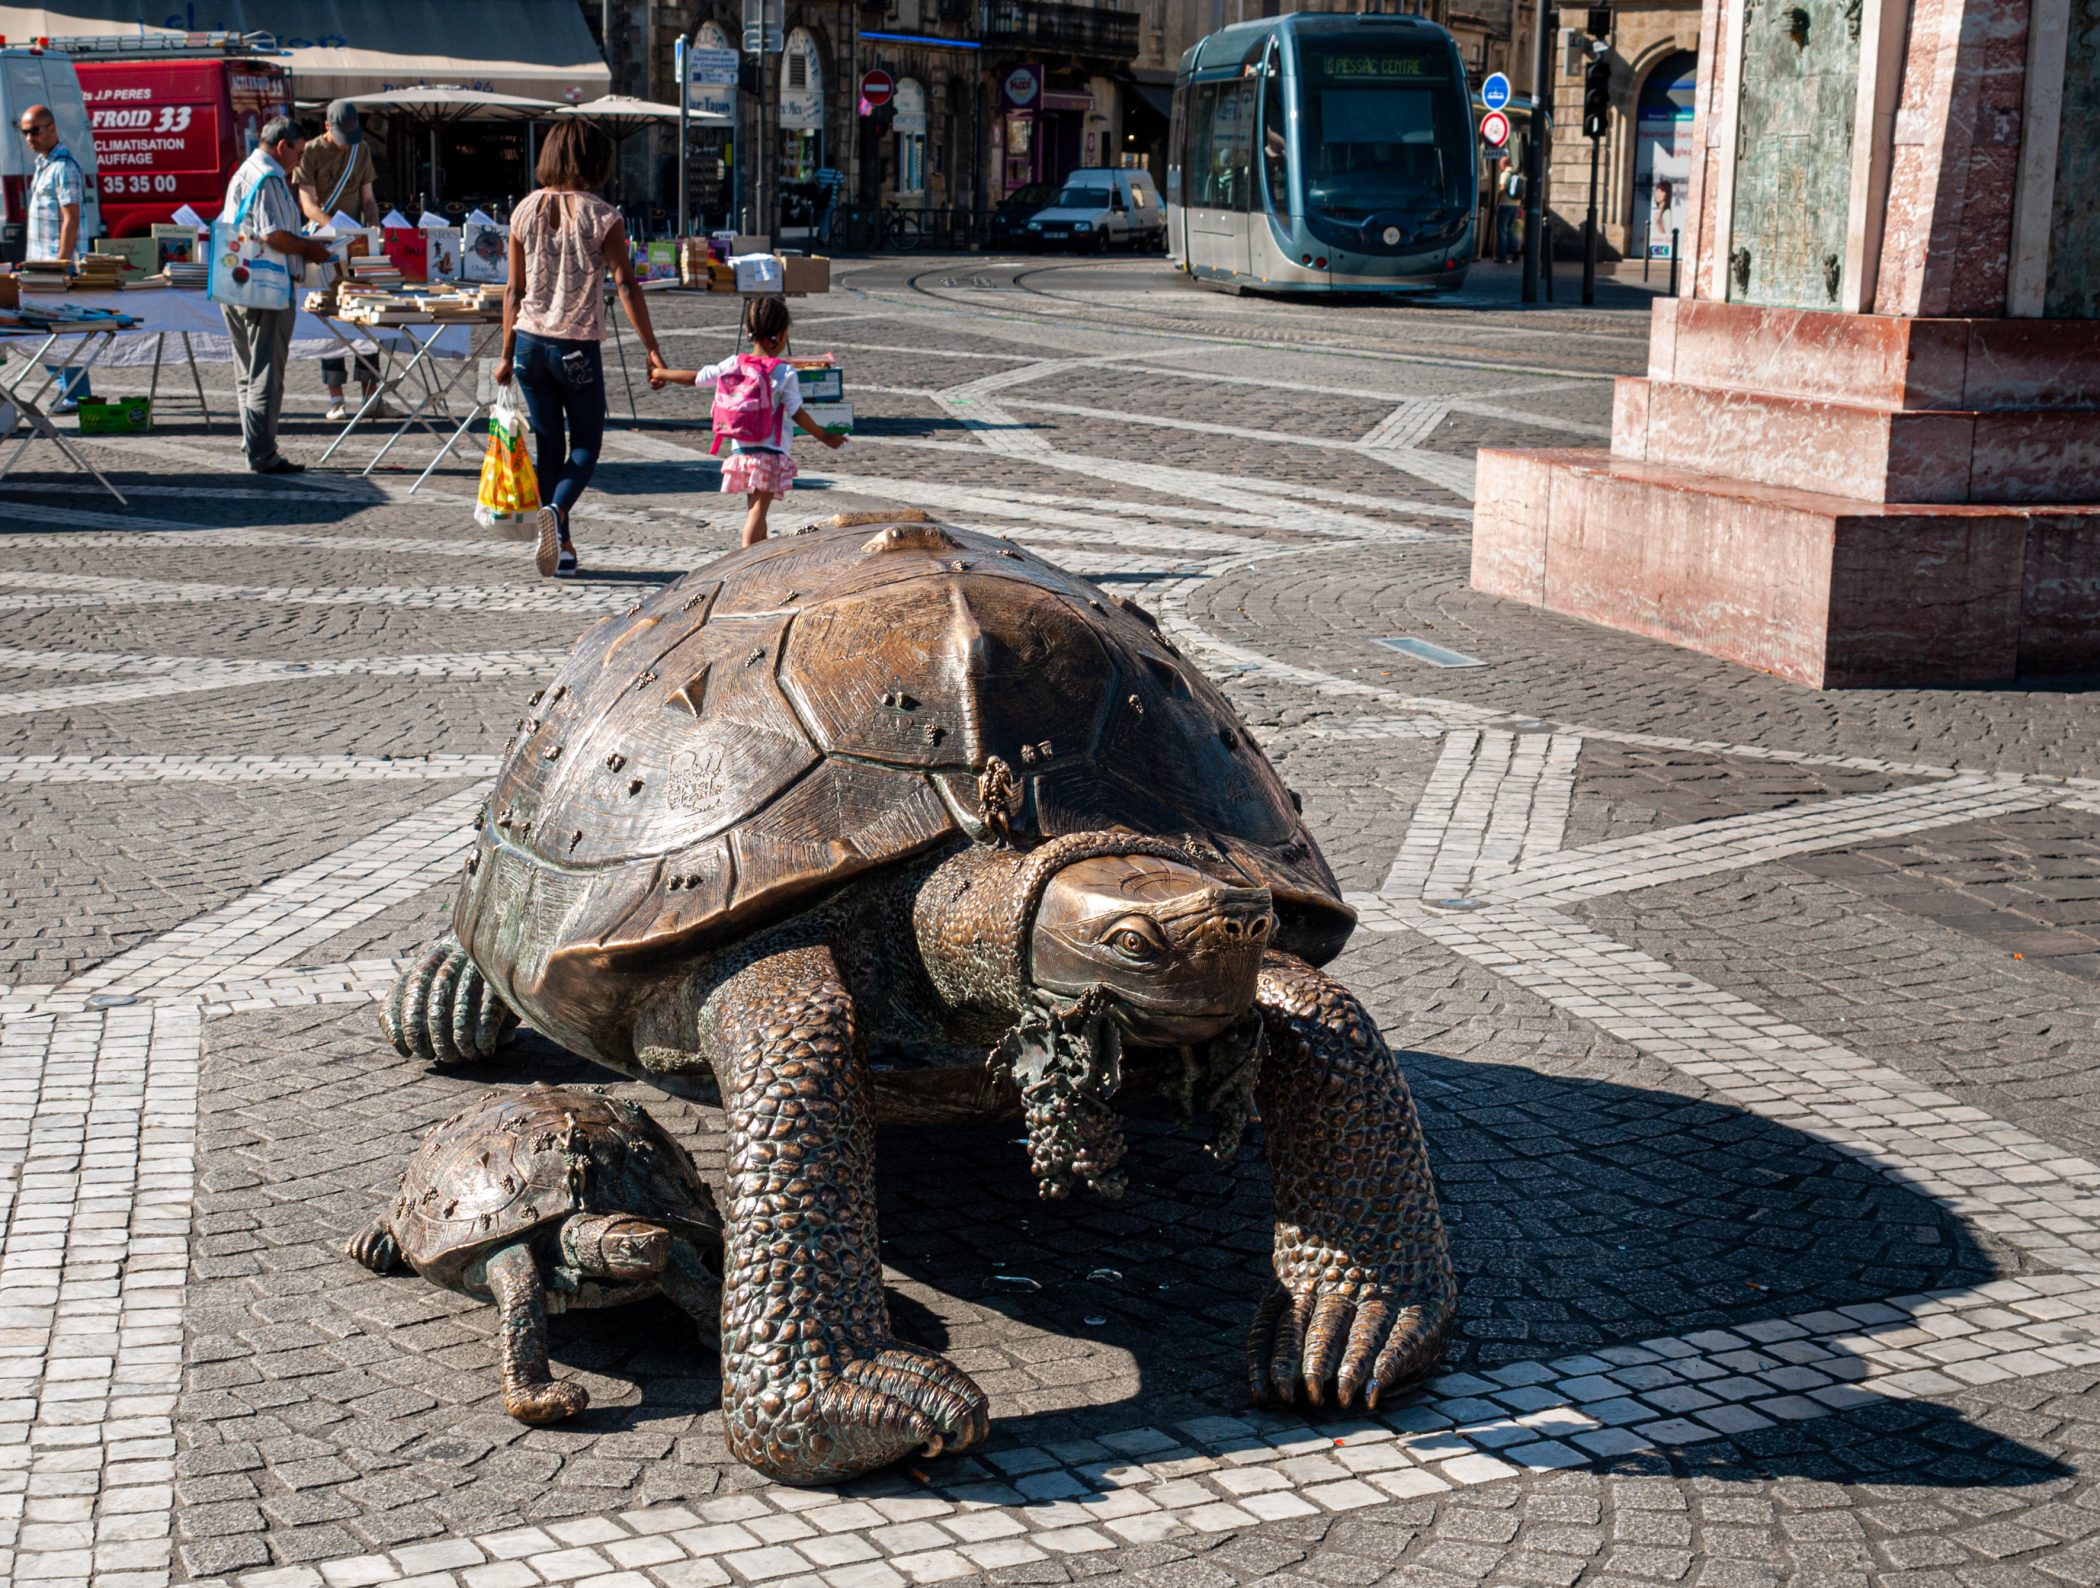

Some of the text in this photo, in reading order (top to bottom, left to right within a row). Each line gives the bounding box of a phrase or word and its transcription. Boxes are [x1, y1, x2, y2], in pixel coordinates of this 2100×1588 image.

[113, 88, 152, 100] PERES
[92, 106, 193, 133] FROID 33
[94, 138, 185, 151] CLIMATISATION
[104, 175, 177, 194] 35 35 00
